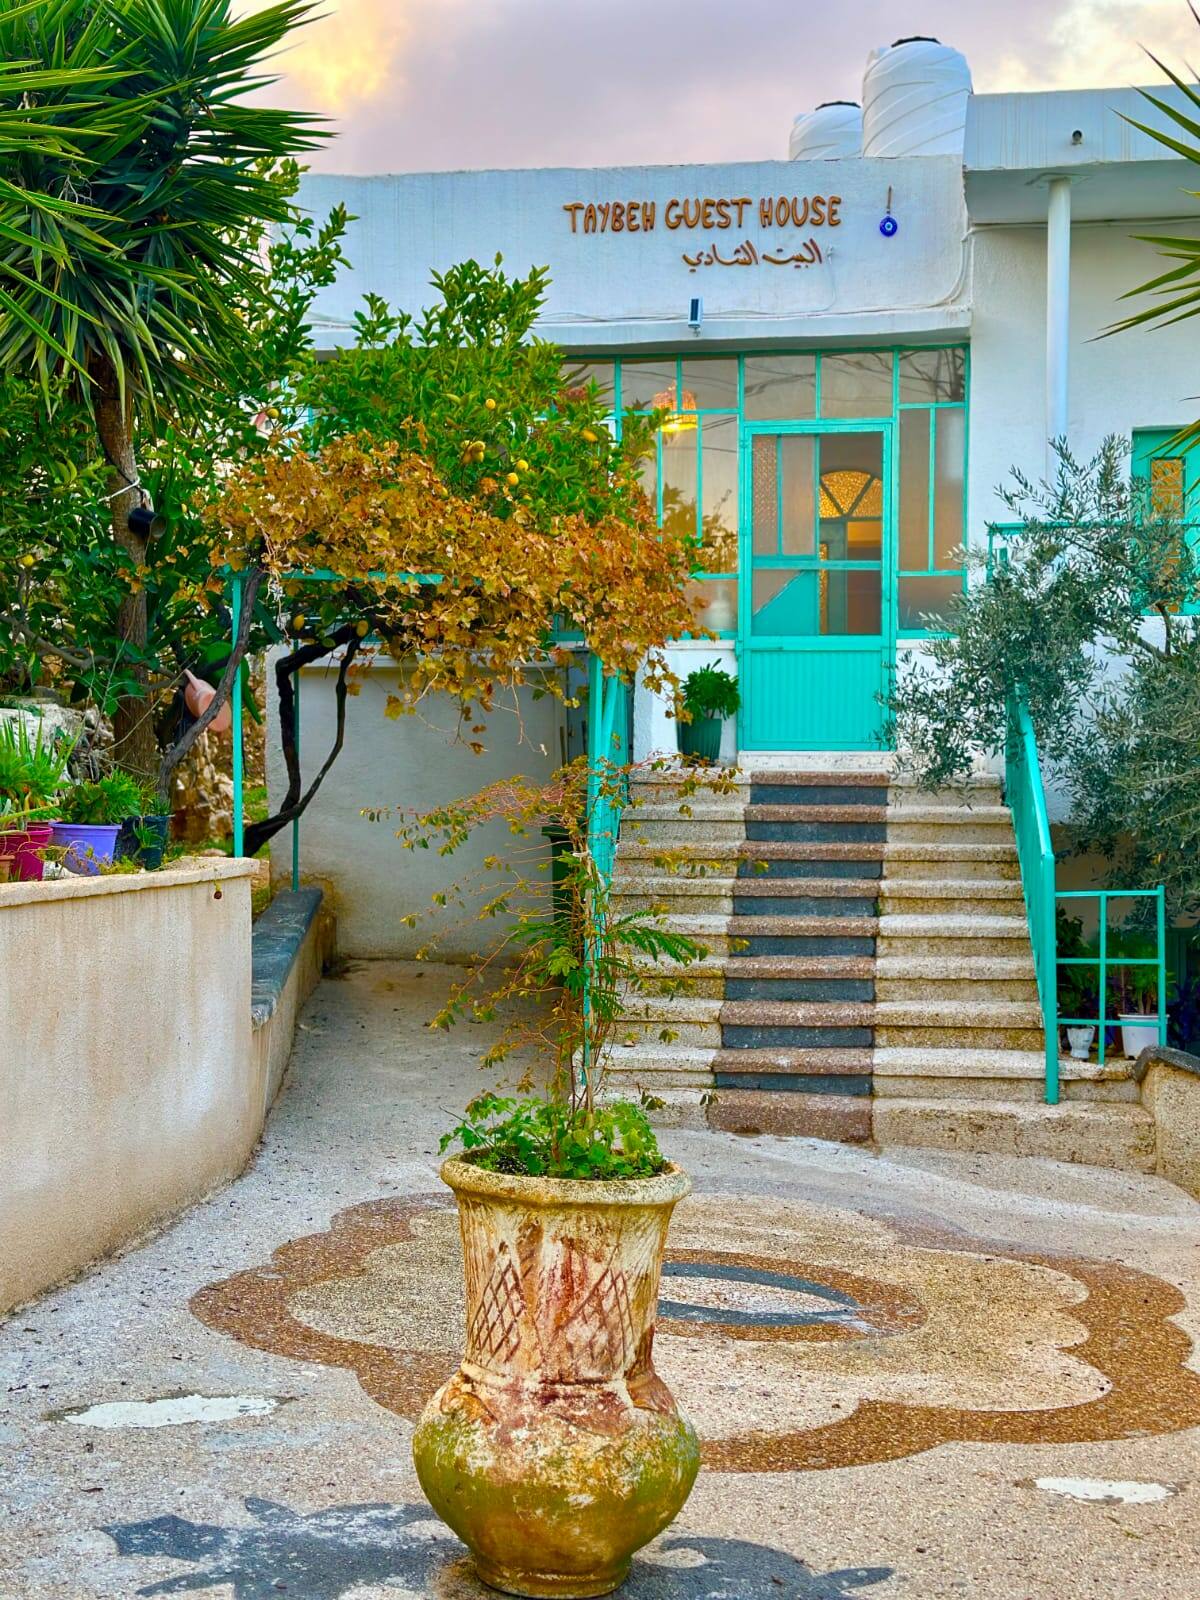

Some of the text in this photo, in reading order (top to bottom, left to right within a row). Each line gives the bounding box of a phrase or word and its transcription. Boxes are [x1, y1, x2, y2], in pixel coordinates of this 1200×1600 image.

[563, 195, 842, 233] TAYBEH GUEST HOUSE
[762, 238, 822, 269] البيت
